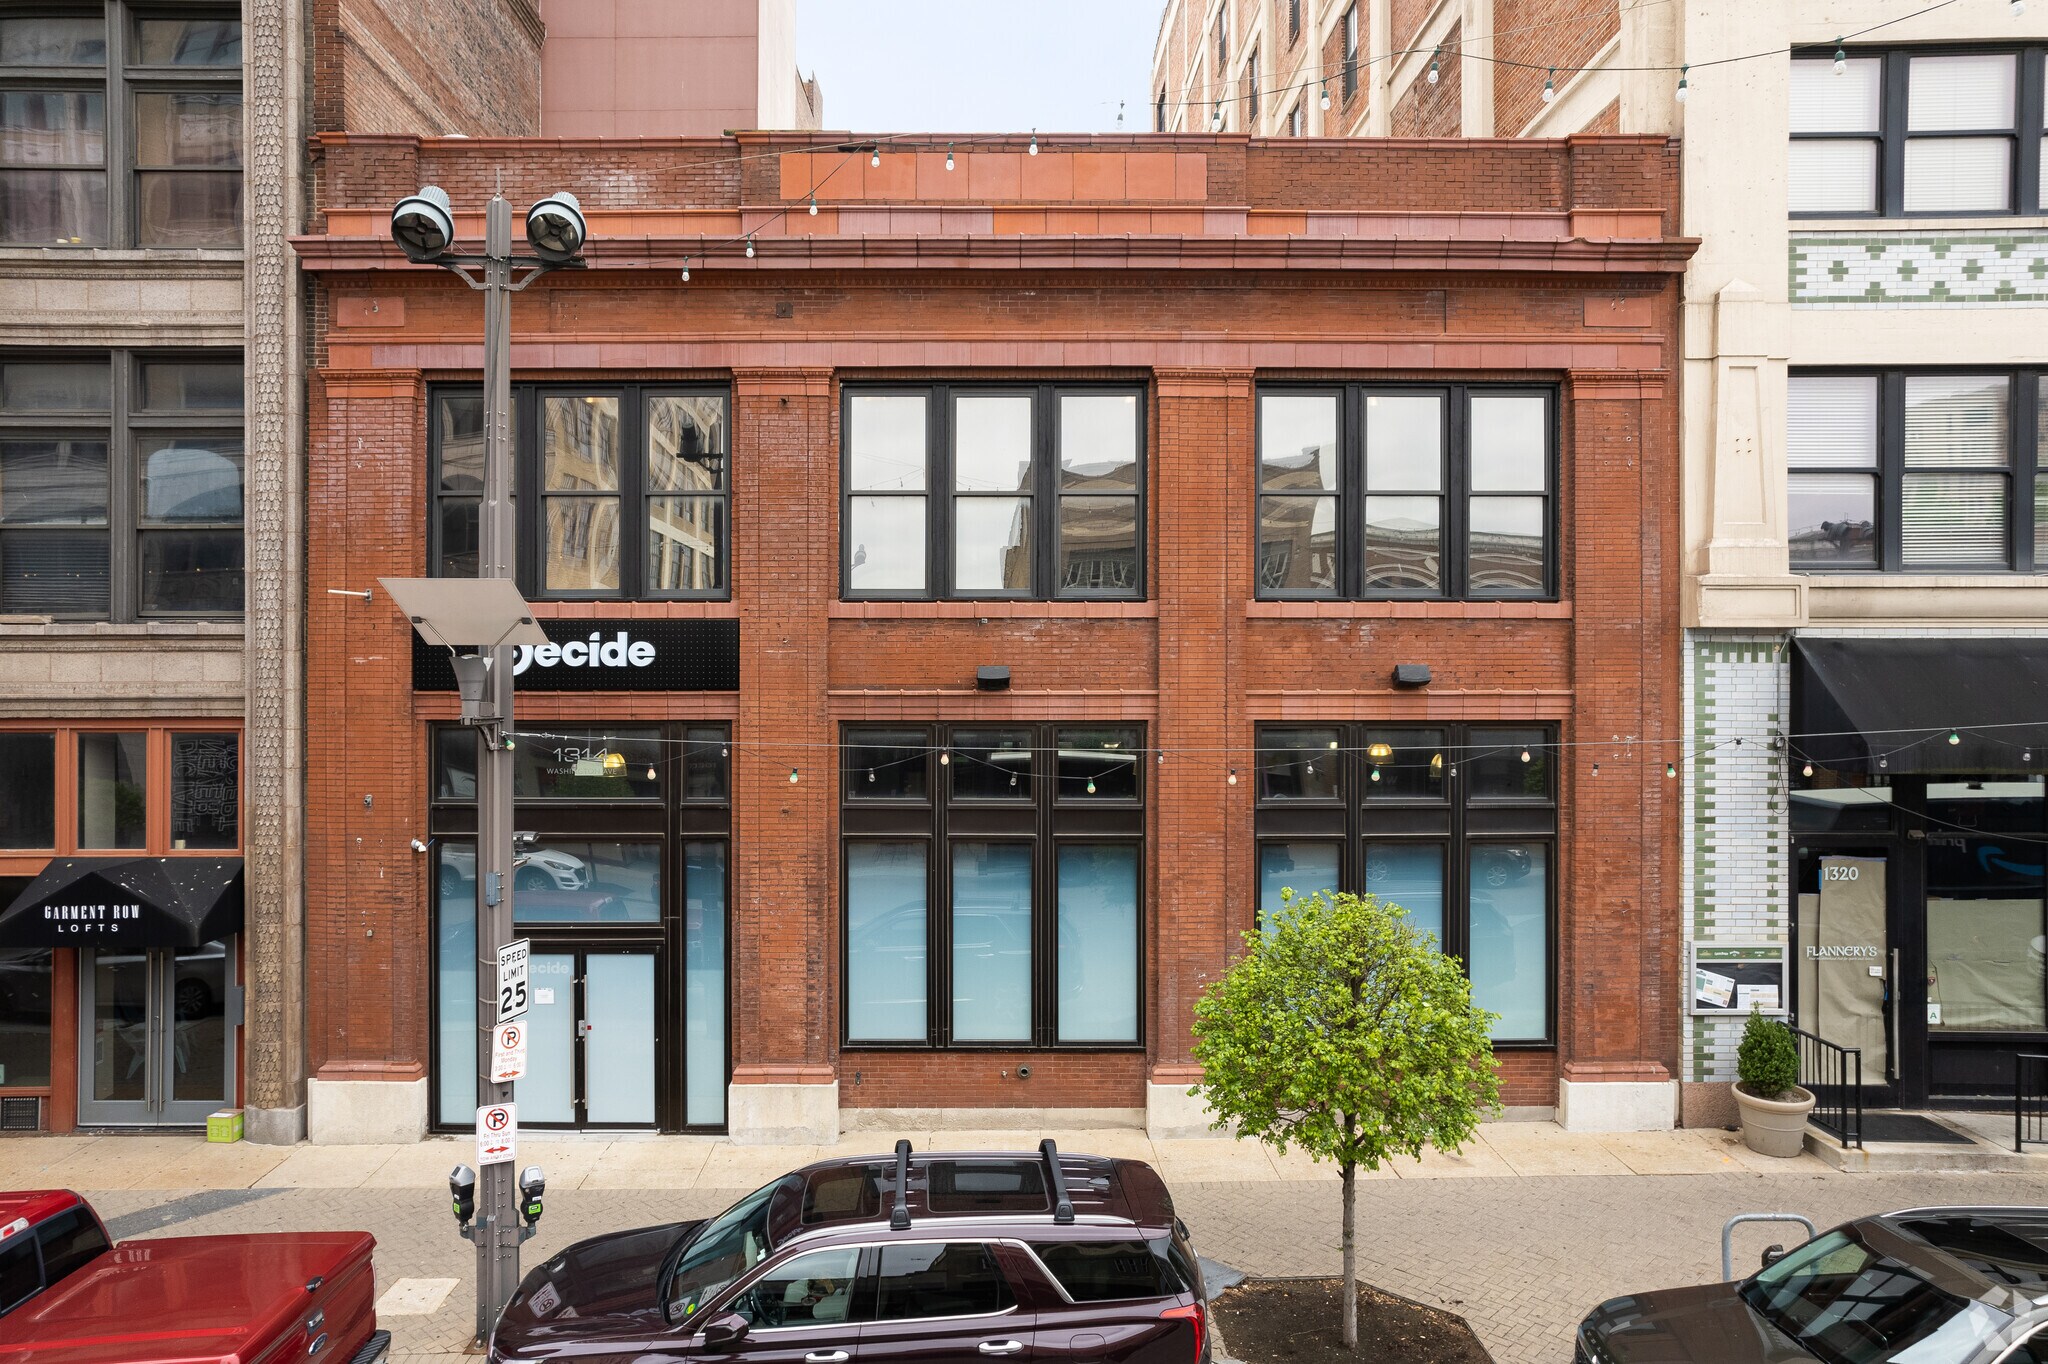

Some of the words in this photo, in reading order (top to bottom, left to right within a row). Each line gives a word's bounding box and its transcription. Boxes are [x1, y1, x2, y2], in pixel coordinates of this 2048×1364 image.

[552, 747, 608, 762] 1314
[1823, 865, 1859, 881] 1320
[44, 904, 106, 920] GARMENT
[113, 904, 140, 919] ROW
[57, 923, 119, 933] LOFTS
[501, 948, 527, 967] SPEED
[1806, 945, 1878, 958] FLANNERY'S
[503, 965, 524, 982] LIMIT
[529, 961, 570, 975] ecide
[501, 980, 527, 1014] 25
